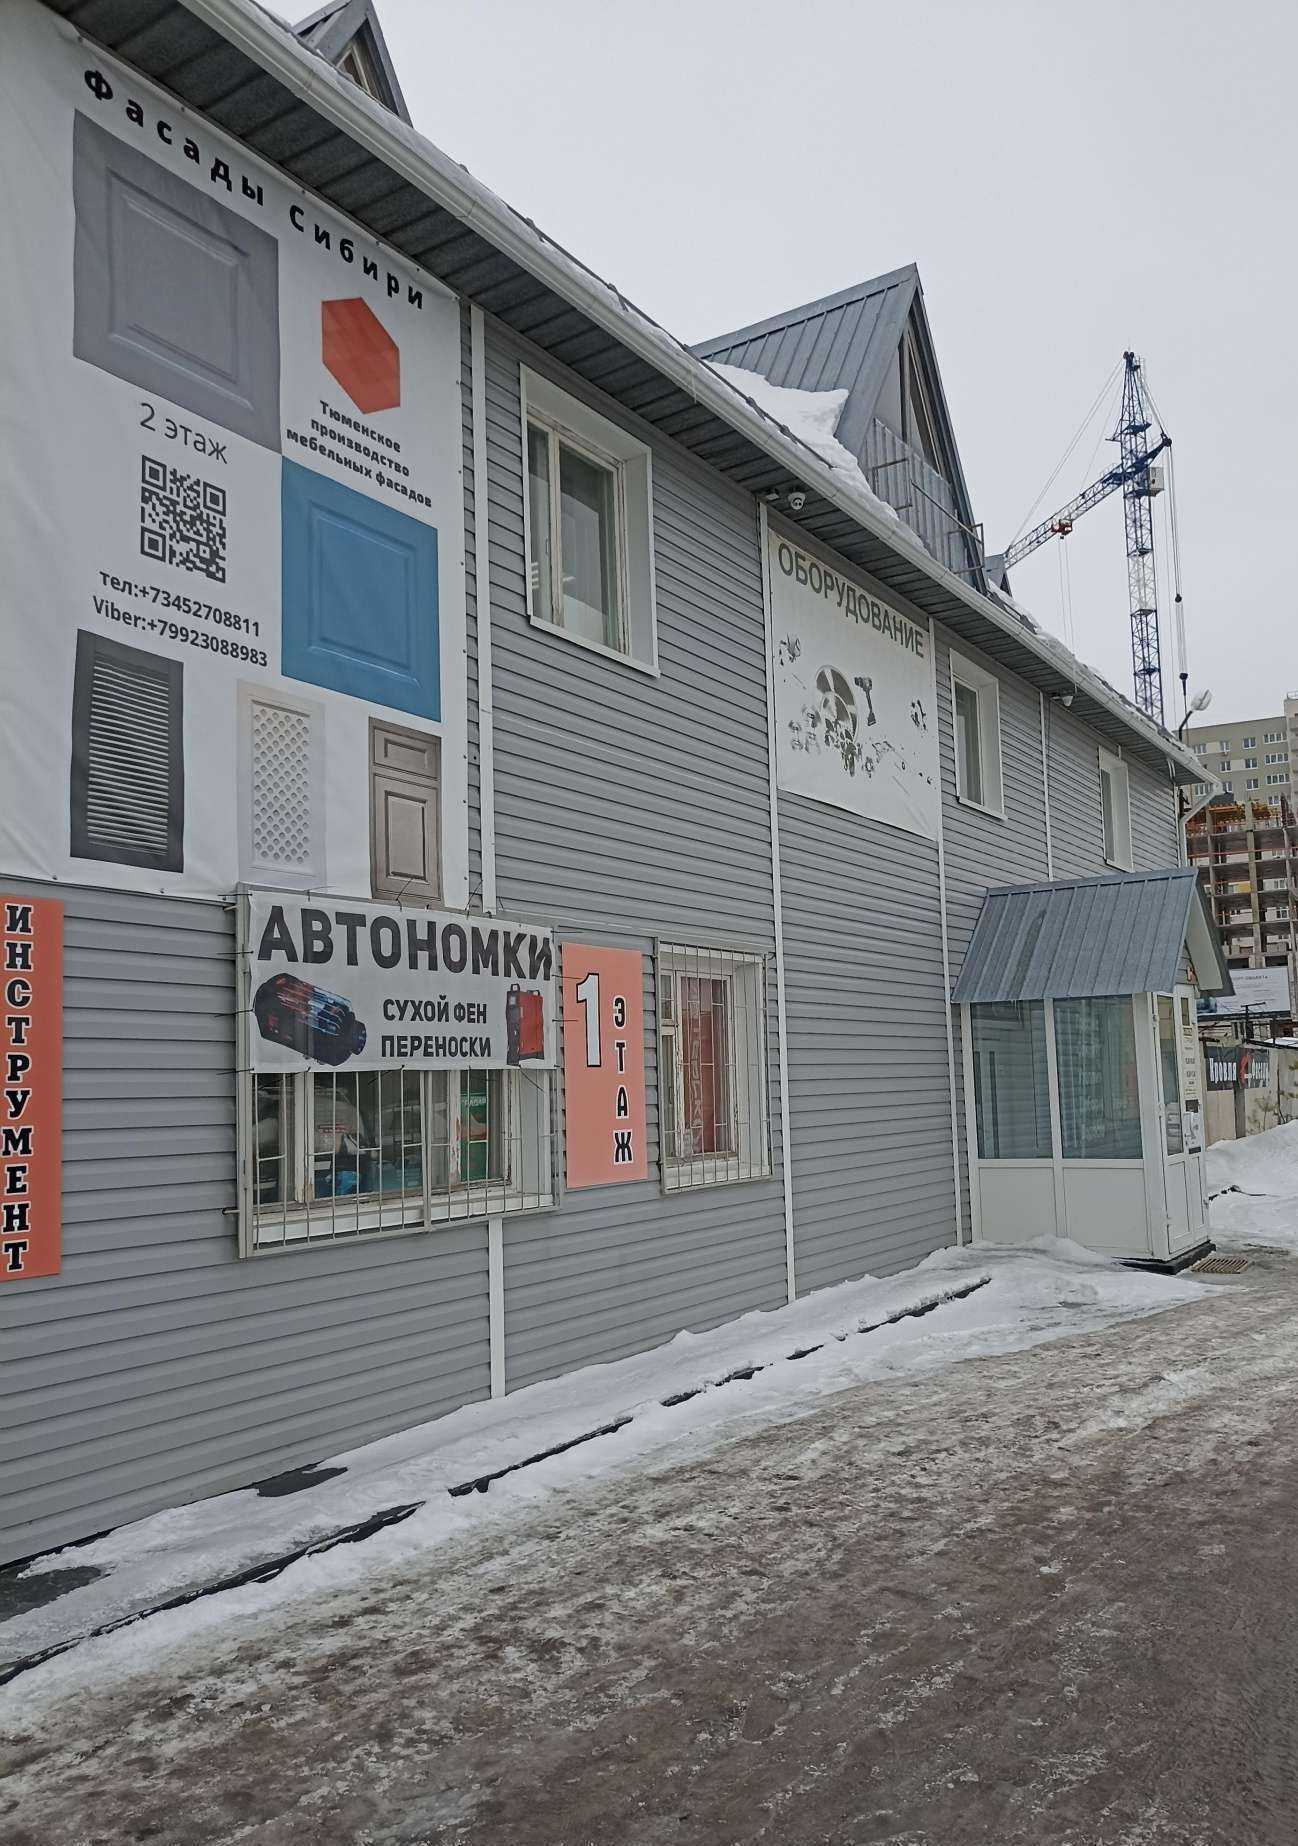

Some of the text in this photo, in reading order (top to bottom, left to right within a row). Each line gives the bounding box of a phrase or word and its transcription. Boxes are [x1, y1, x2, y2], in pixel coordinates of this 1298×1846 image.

[84, 69, 424, 310] Фасады Сибири
[140, 402, 228, 465] 2 этаж
[311, 419, 410, 477] производство
[320, 399, 401, 453] Тюменское
[286, 428, 432, 508] мебельных фасадов
[93, 595, 268, 667] Viber:+79923088983
[99, 571, 261, 637] тел:+73452708811
[778, 543, 925, 659] ОБОРУДОВАНИЕ
[257, 904, 553, 982] АВТОНОМКИ
[383, 995, 487, 1024] СУХОЙ ФЕН
[381, 1035, 492, 1058] ПЕРЕНОСКИ
[576, 972, 634, 1166] 1 ЭТАЖ
[1209, 1057, 1237, 1084] Кровля
[1, 904, 34, 1273] ИНСТРУМЕНТ
